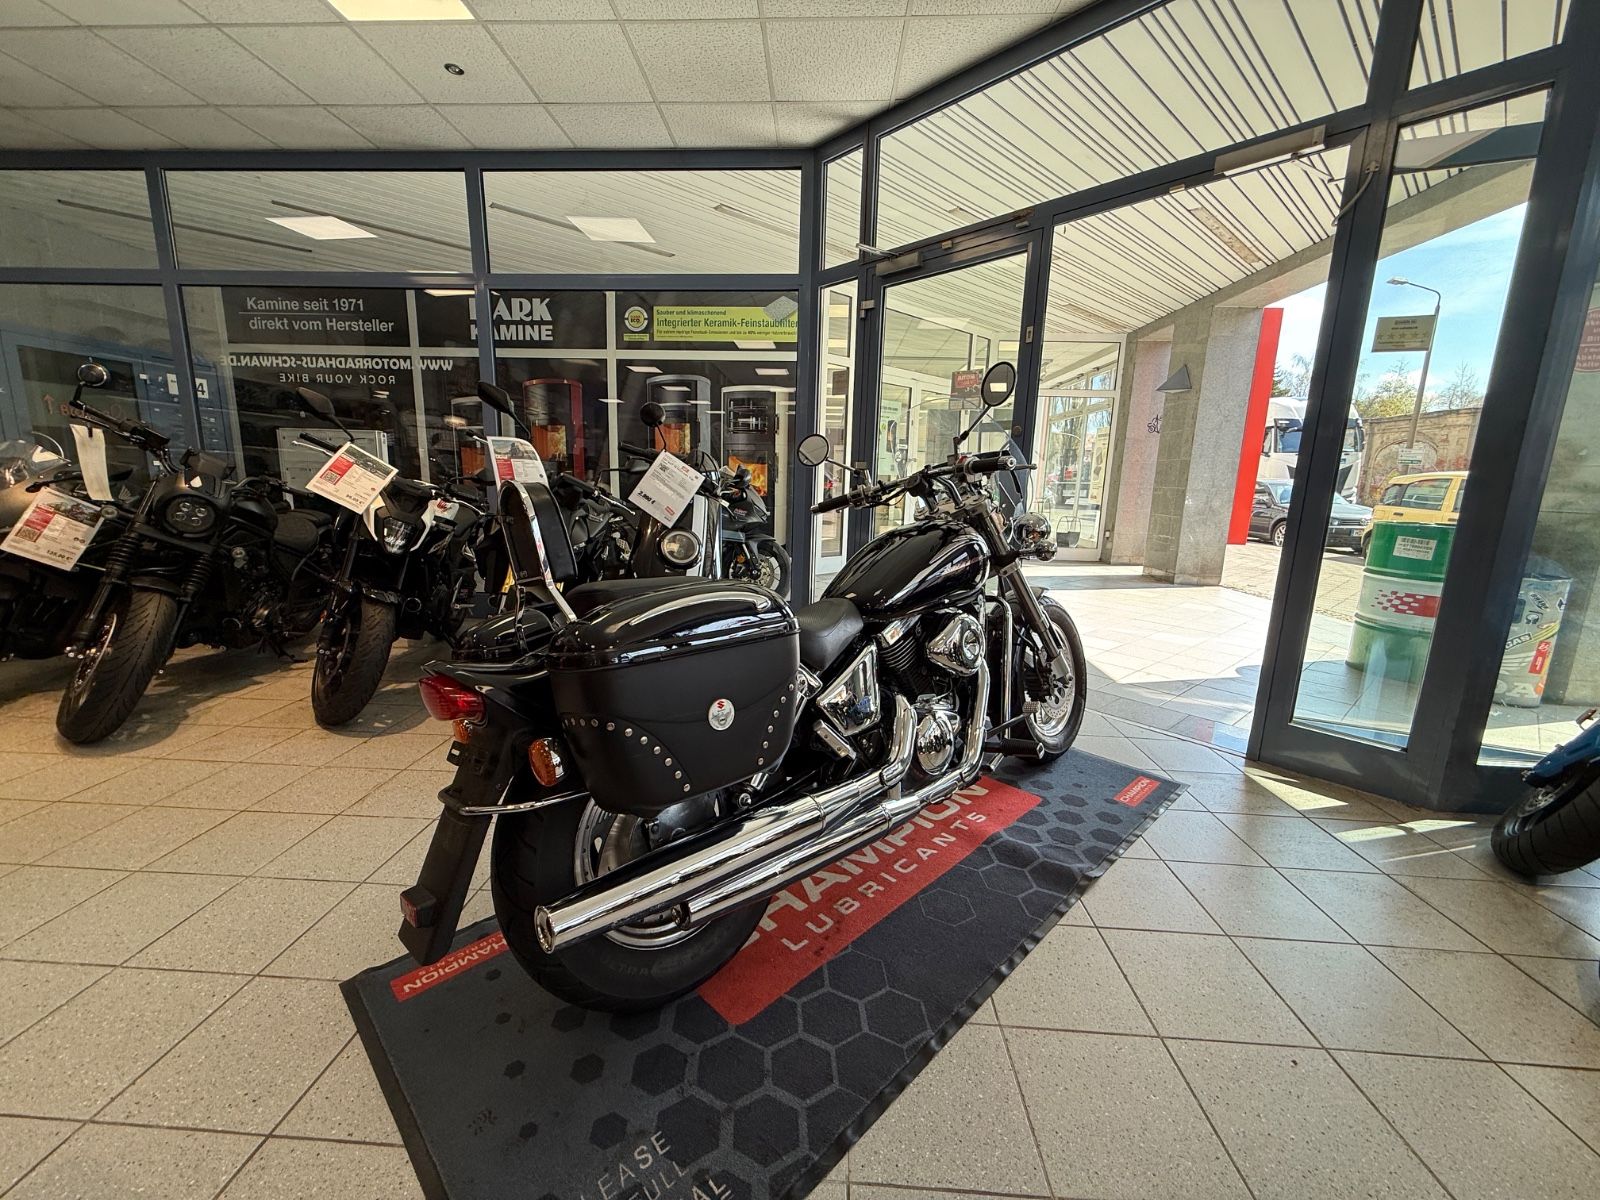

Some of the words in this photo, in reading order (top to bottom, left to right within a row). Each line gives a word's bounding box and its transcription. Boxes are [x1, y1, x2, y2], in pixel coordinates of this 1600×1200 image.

[246, 297, 300, 311] Kamine
[303, 298, 329, 311] seit
[332, 298, 364, 312] 1971
[249, 316, 288, 331] direkt
[293, 320, 322, 331] vom
[325, 318, 394, 332] Hersteller
[656, 318, 701, 329] Integrierter
[196, 382, 206, 396] 4
[741, 783, 990, 950] HAMPION
[780, 811, 987, 952] LUBRICANTS
[403, 938, 508, 993] HAMPION
[579, 1130, 672, 1200] EASE
